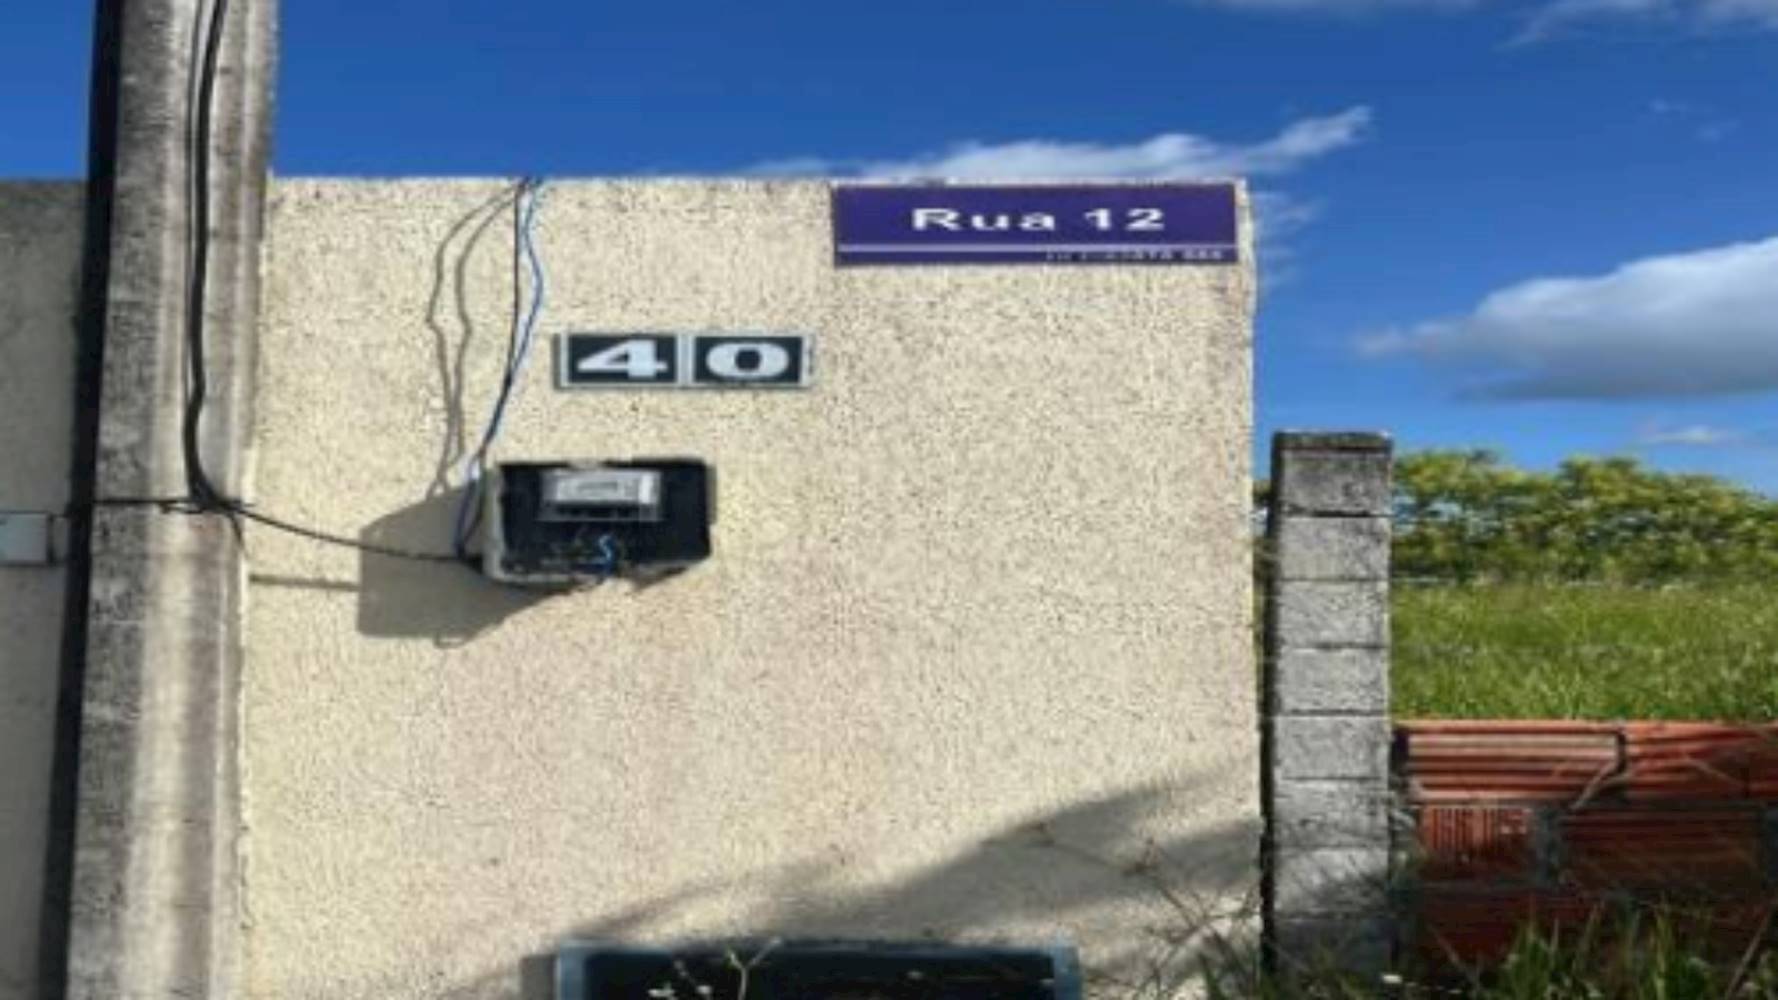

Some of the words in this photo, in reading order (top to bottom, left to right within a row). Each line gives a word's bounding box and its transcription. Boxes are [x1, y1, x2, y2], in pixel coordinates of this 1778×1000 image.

[911, 208, 1054, 231] Rua
[1084, 208, 1165, 231] 12
[577, 339, 790, 380] 40
